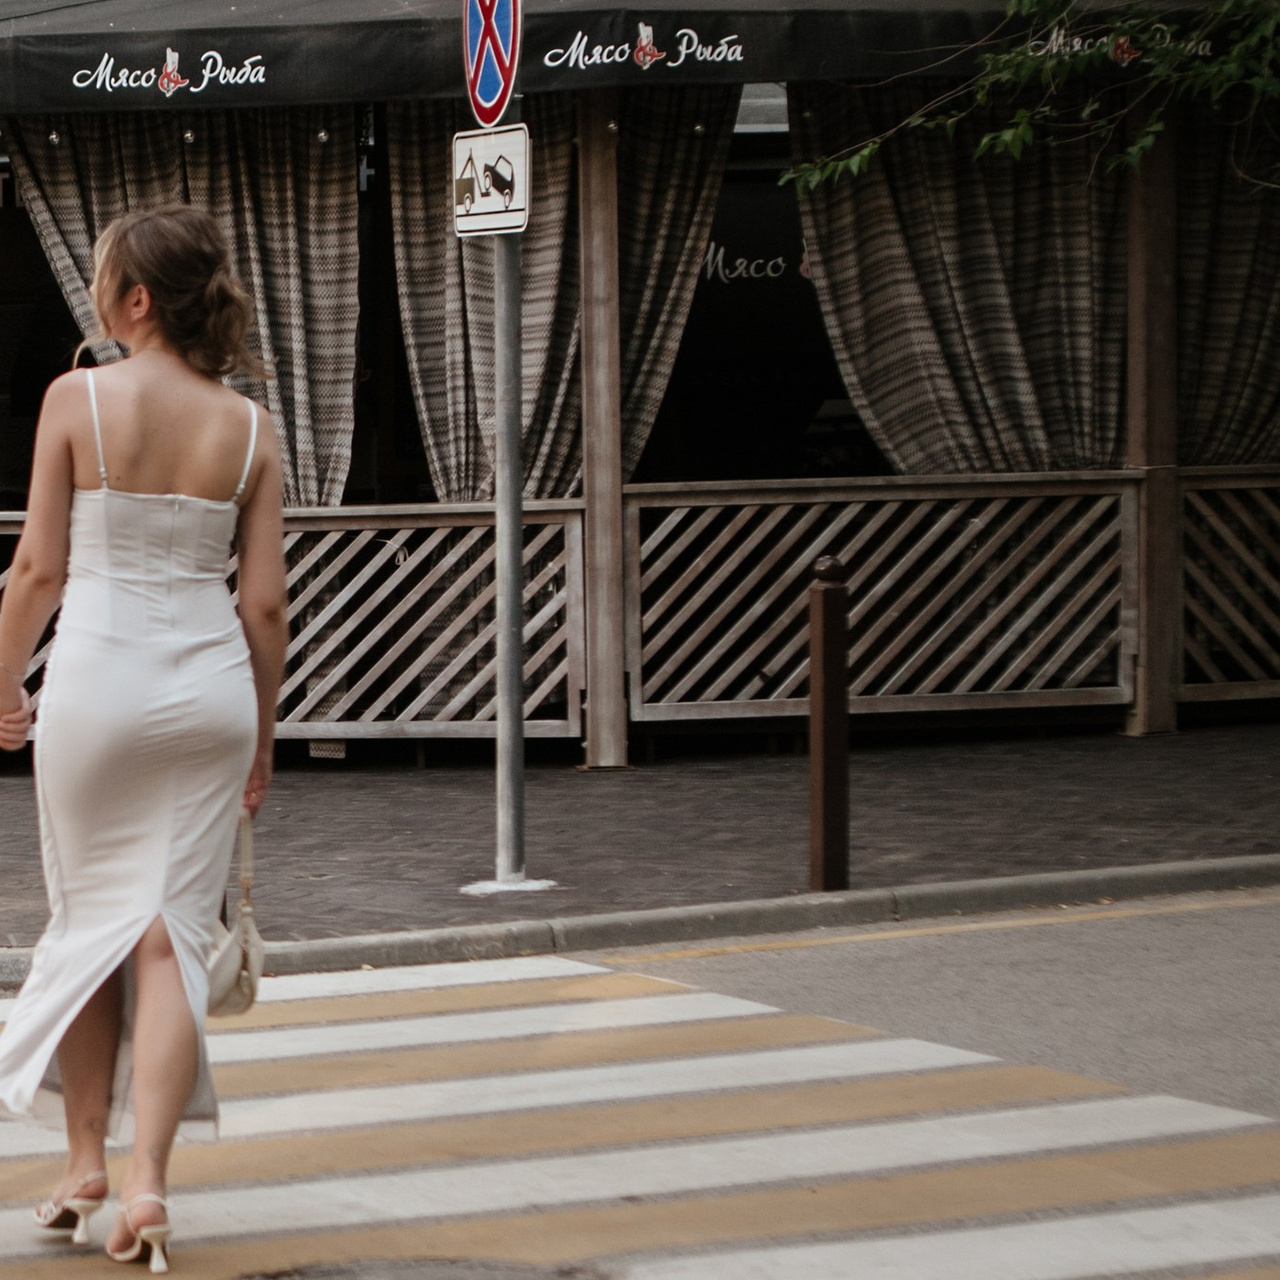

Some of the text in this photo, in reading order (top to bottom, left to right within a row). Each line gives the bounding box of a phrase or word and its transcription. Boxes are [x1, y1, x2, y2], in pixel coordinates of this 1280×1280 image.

[543, 30, 630, 69] Мясо
[666, 28, 744, 67] Рыба
[72, 52, 157, 92] Мясо
[189, 51, 266, 92] Рыба
[703, 241, 787, 283] Мясо
